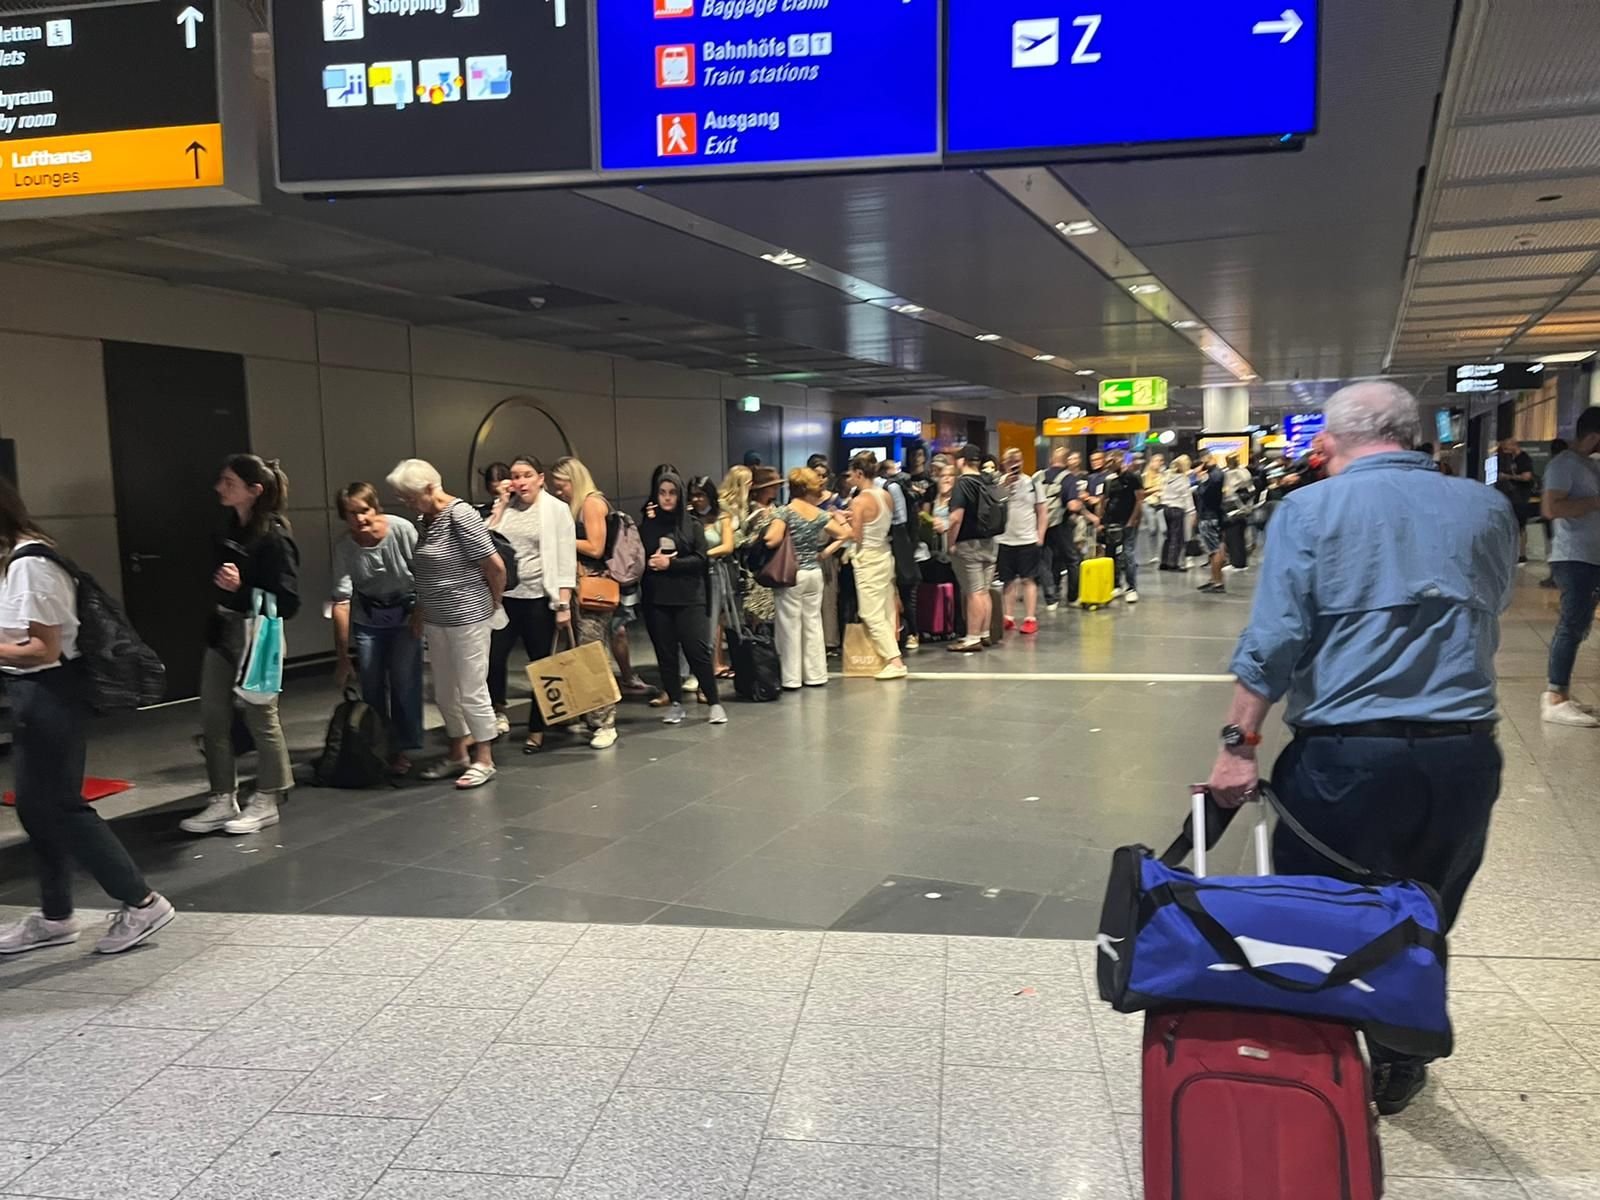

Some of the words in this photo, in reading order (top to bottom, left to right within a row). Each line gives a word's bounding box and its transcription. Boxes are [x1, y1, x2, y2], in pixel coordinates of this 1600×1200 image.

[701, 0, 777, 20] Baggage
[703, 37, 786, 61] Bahnhöfe
[1071, 14, 1102, 64] Z
[703, 66, 745, 86] Train
[748, 62, 820, 84] stations
[18, 113, 57, 128] room
[703, 110, 780, 133] Ausgang
[704, 135, 738, 155] Exit
[12, 149, 92, 168] Lufthansa
[14, 171, 80, 188] Lounges
[540, 676, 568, 720] hey
